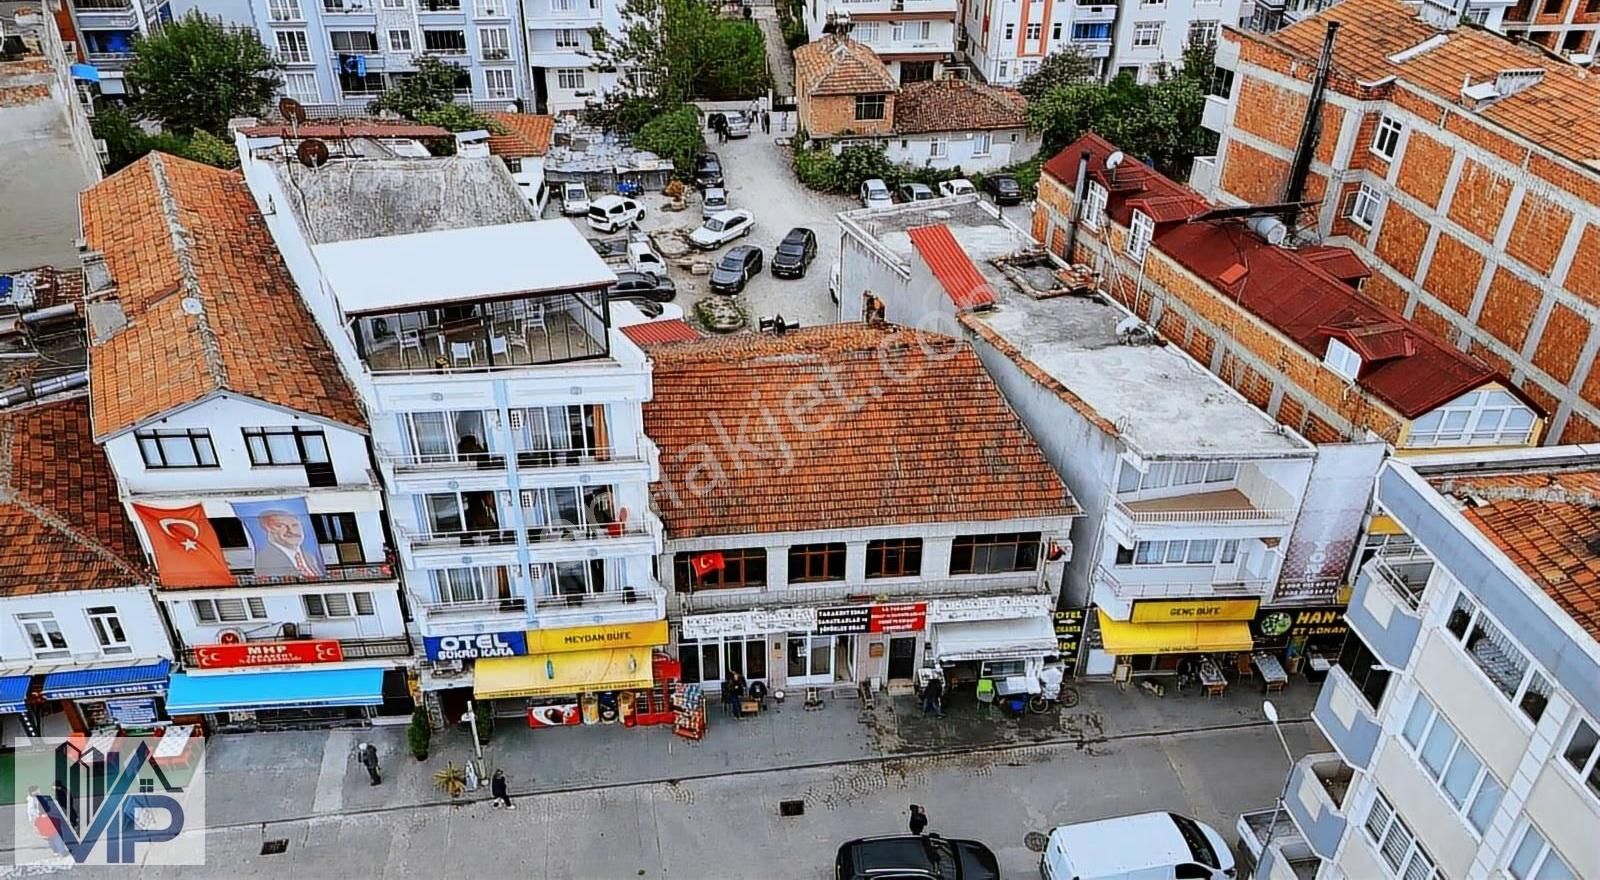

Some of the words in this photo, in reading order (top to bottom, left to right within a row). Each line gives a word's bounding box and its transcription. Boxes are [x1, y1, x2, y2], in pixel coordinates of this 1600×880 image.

[1292, 627, 1307, 636] ET
[440, 634, 508, 651] OTEL
[564, 633, 605, 644] MEYDAN
[248, 645, 287, 655] MHP
[480, 646, 514, 658] KARA
